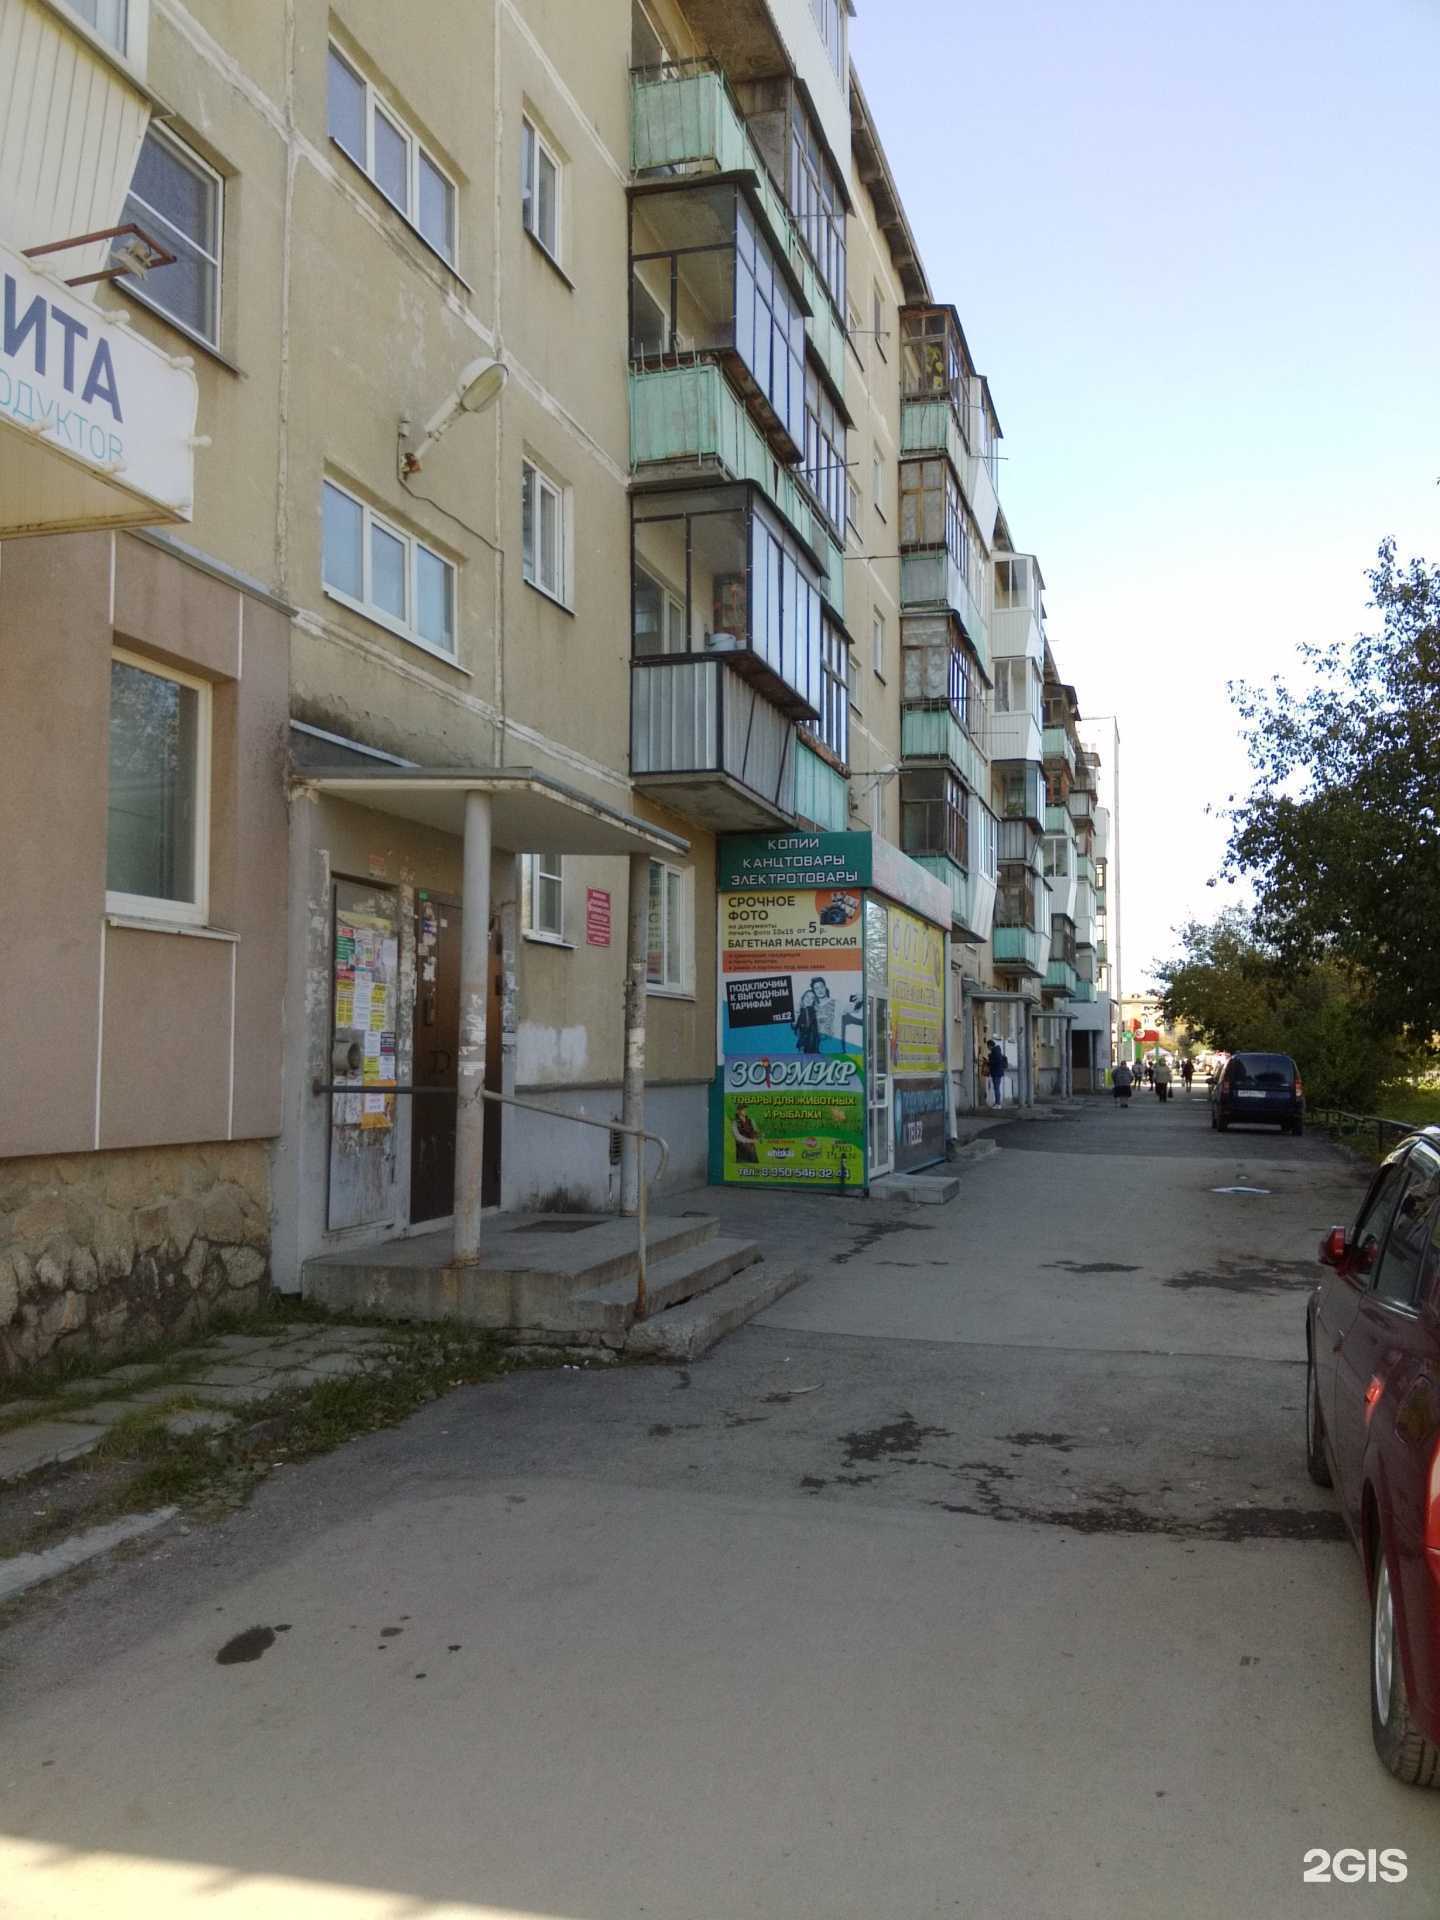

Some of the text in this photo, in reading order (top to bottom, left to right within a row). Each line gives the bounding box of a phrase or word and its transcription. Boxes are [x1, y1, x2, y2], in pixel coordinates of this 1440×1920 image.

[767, 838, 820, 850] КОПИИ
[743, 855, 846, 869] КАНЦТОВАРЫ
[731, 871, 858, 886] ЭЛЕКТРОТОВАРЫ
[728, 895, 796, 908] СРОЧНОЕ
[728, 909, 769, 921] ФОТО
[808, 921, 818, 934] 5
[728, 936, 858, 948] БАГЕТНАЯ МАСТЕРСКАЯ
[729, 979, 788, 993] ПОДКЛЮЧИМ
[737, 988, 790, 1001] ВЫГОДНЫМ
[731, 1000, 772, 1011] ТАРИФАМ
[731, 1059, 858, 1088] ЗООМИР
[735, 1095, 856, 1106] ТОВАРЫ ДЛЯ ЖИВОТНЫХ
[772, 1109, 822, 1120] РЫБАЛКИ
